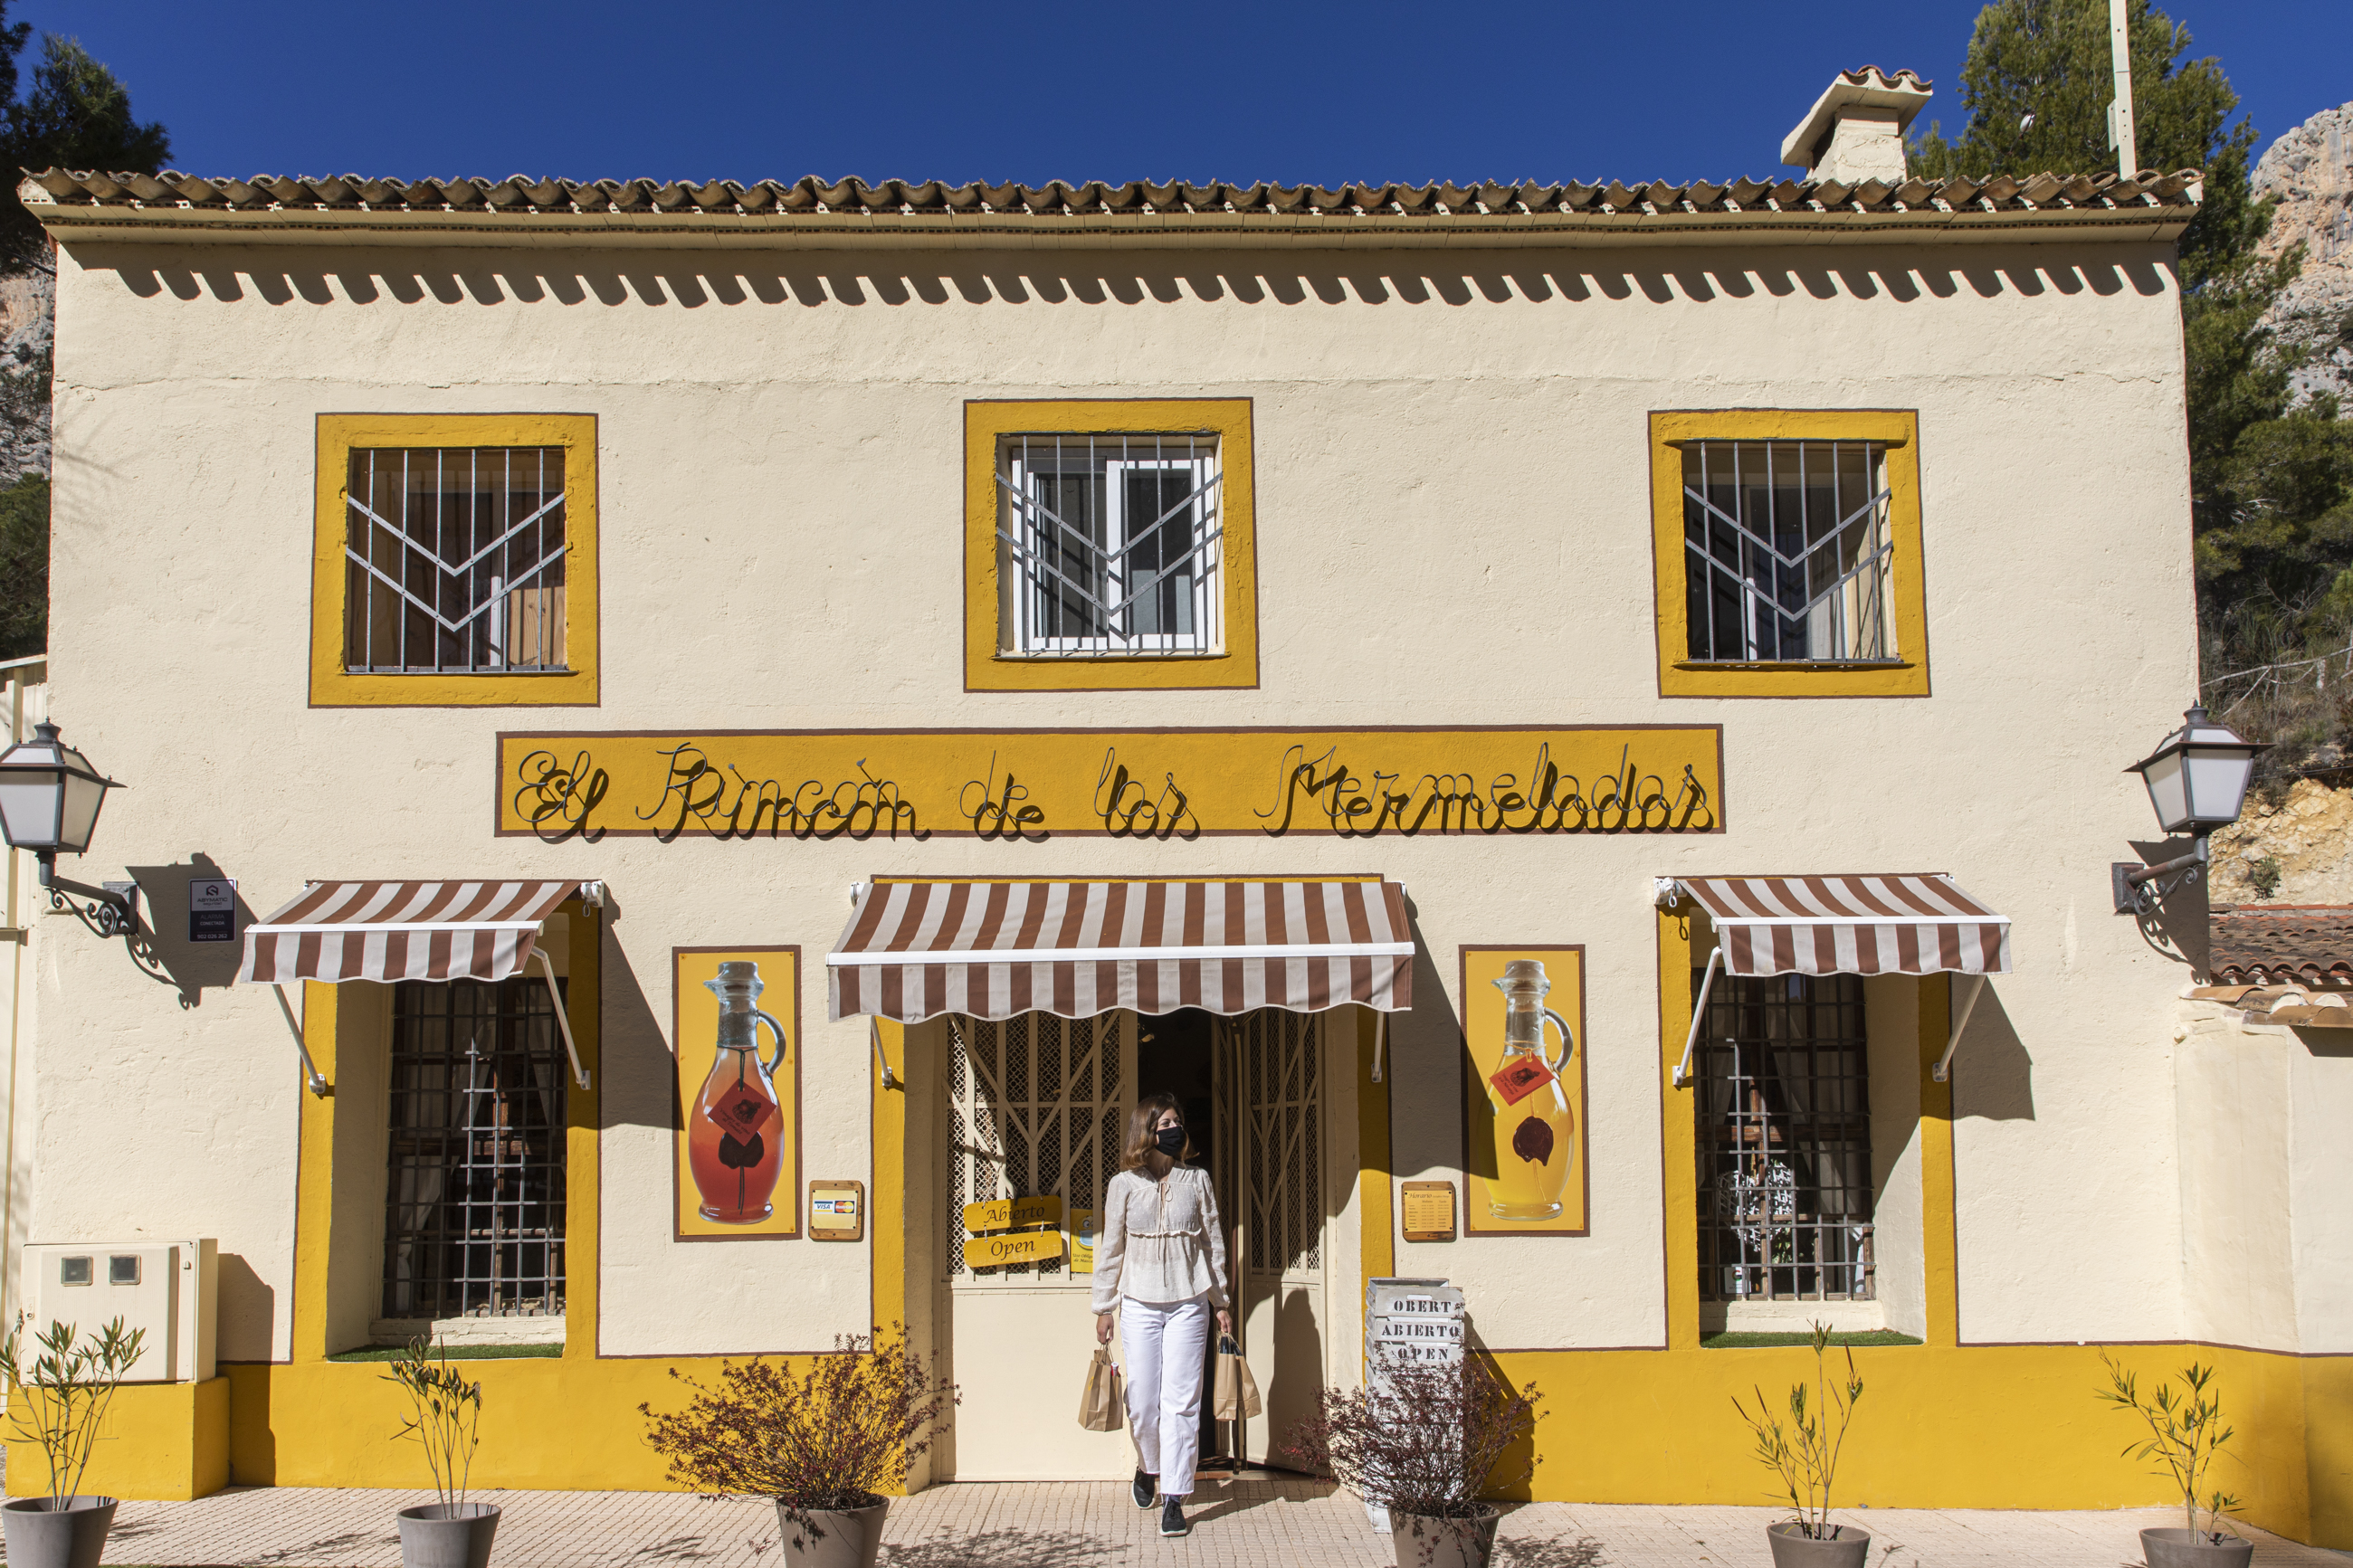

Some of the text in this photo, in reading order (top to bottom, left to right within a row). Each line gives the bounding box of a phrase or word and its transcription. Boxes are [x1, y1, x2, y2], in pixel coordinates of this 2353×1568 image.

[513, 749, 589, 822] El
[959, 749, 1038, 820] de
[1253, 741, 1709, 818] Mermeladas
[983, 1205, 1045, 1223] Abierto
[990, 1240, 1036, 1261] Open
[1394, 1300, 1452, 1312] OBERT
[1381, 1324, 1460, 1337] ABIERTO
[1397, 1348, 1449, 1360] OPEN
